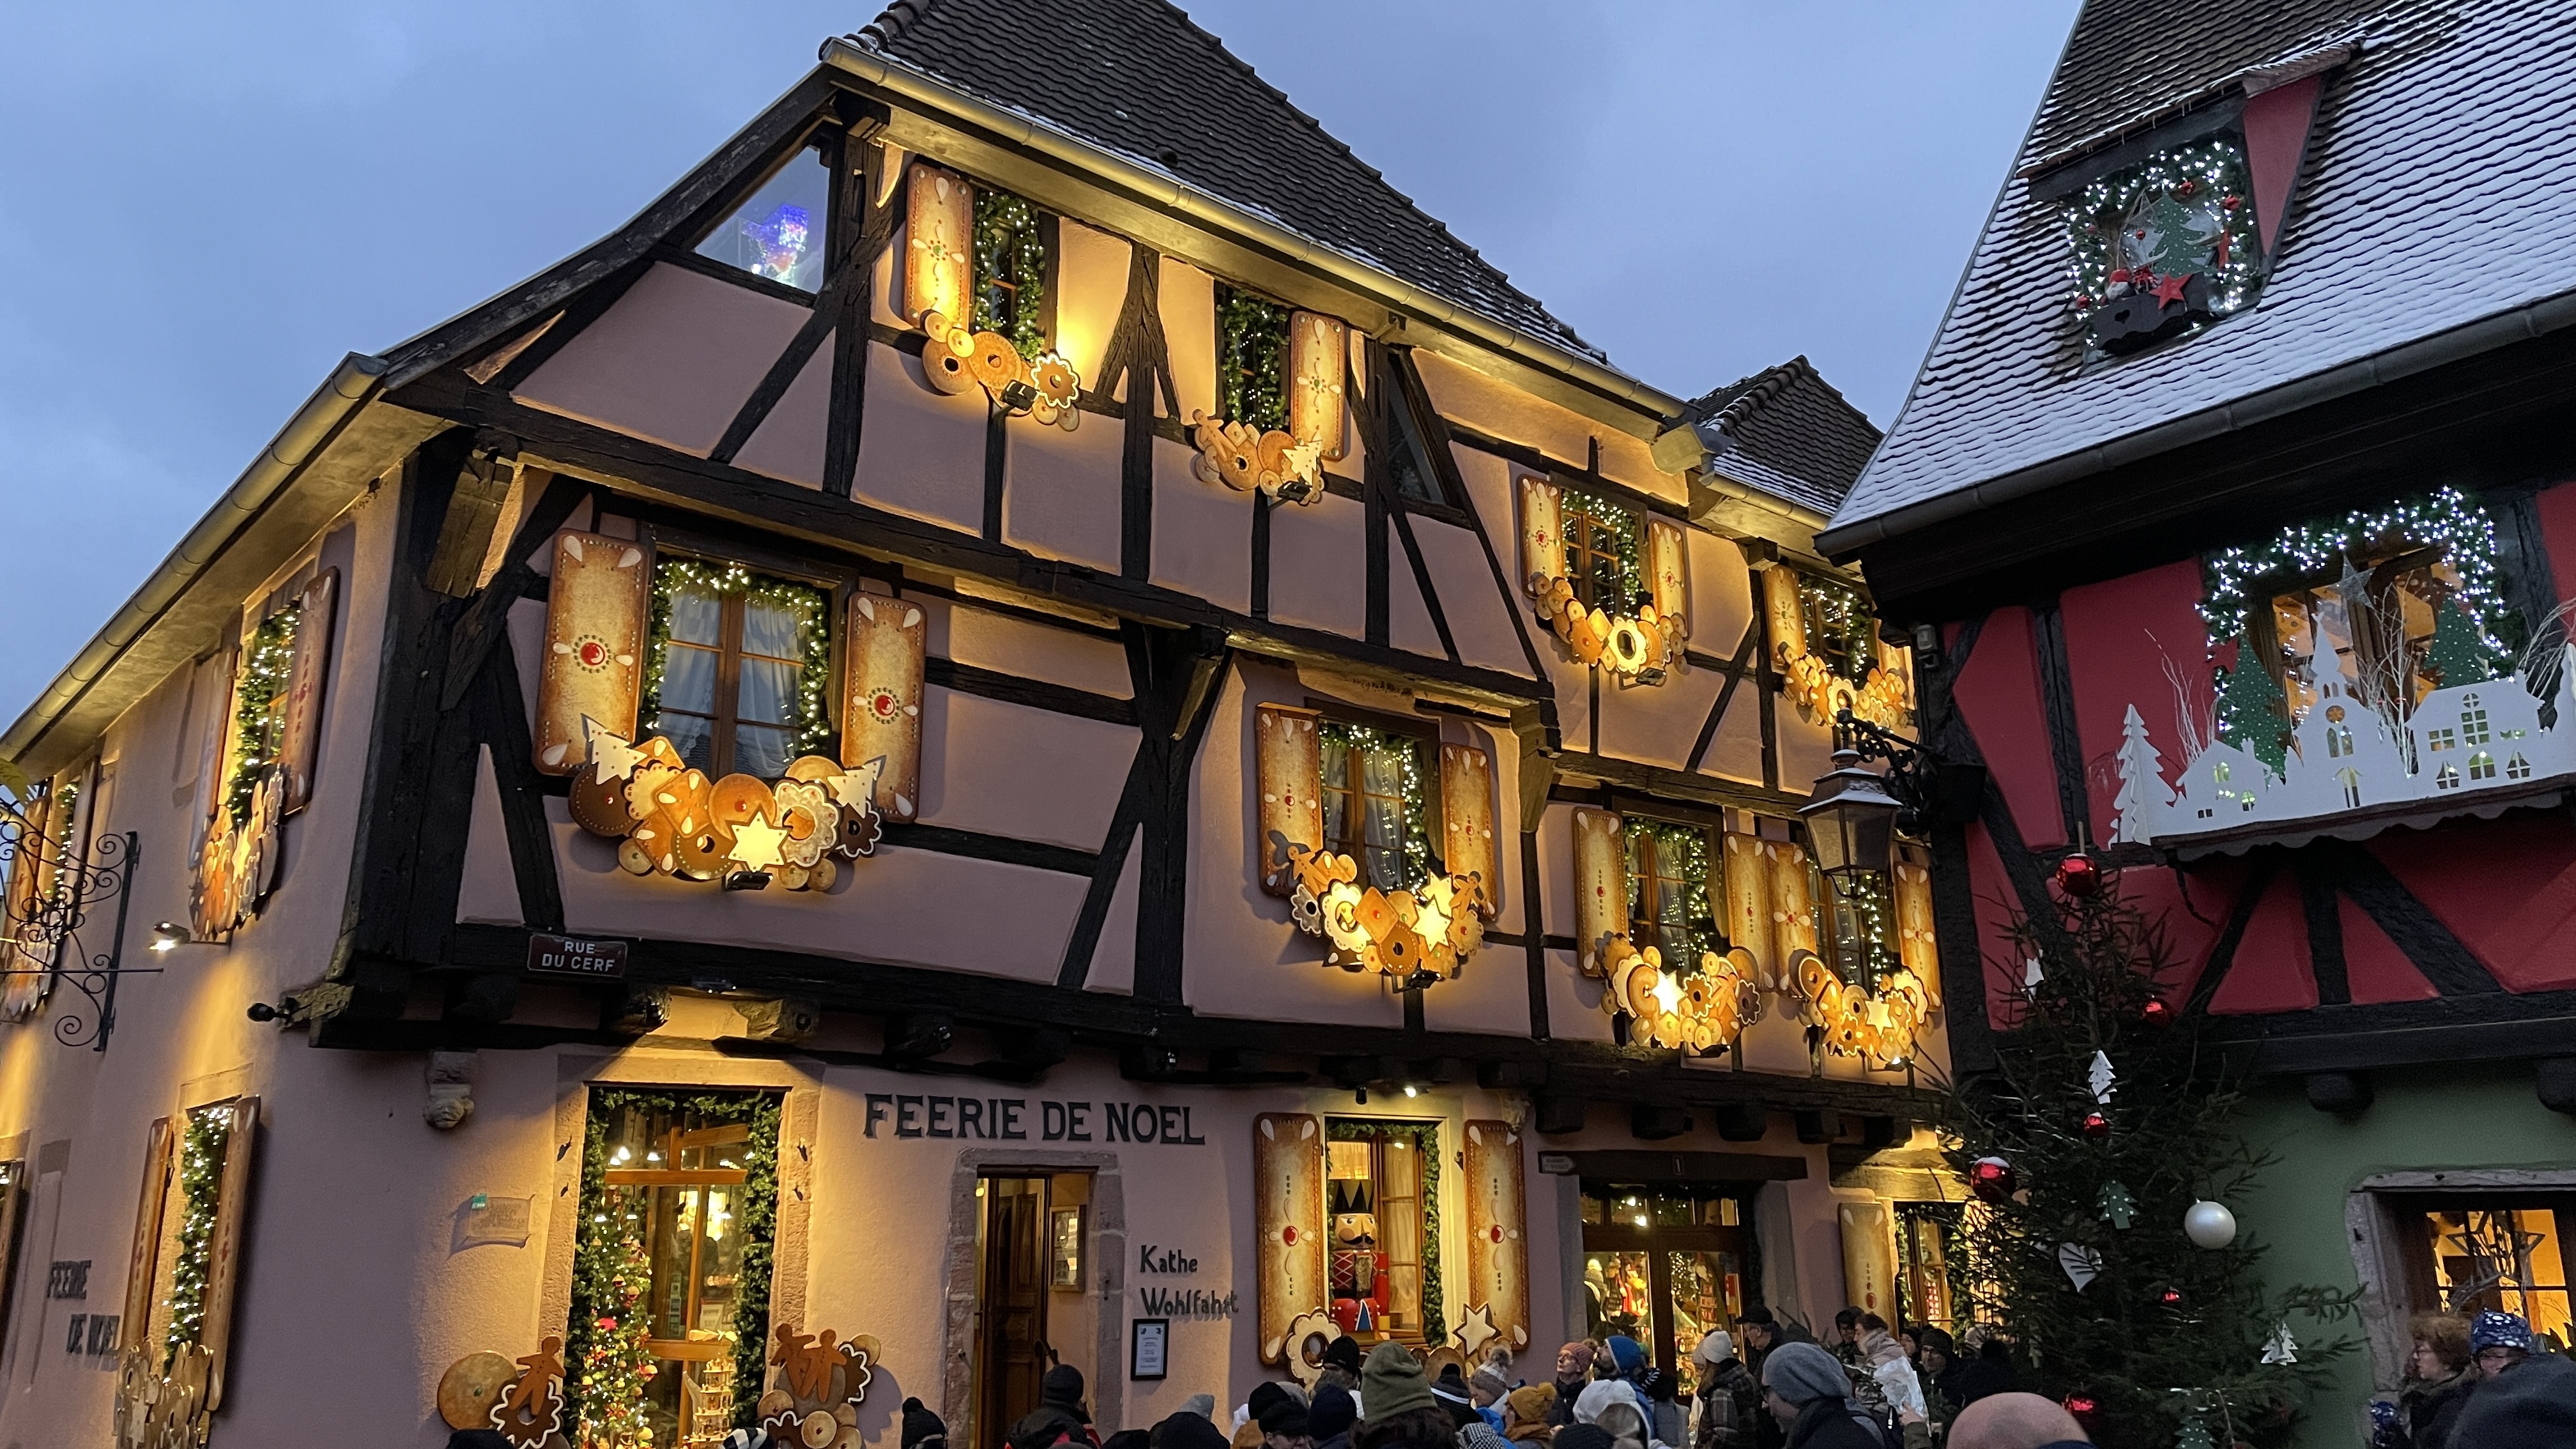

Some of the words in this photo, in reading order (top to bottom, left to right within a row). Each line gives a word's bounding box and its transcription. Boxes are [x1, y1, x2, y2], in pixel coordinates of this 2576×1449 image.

[564, 941, 595, 954] RUE
[542, 953, 565, 967] DU
[571, 956, 615, 971] CERF
[862, 1093, 1027, 1139] FEERIE
[1041, 1101, 1092, 1141] DE
[1105, 1103, 1206, 1145] NOEL
[1140, 1245, 1198, 1273] Kathe
[1140, 1287, 1239, 1315] Wohlfahrt
